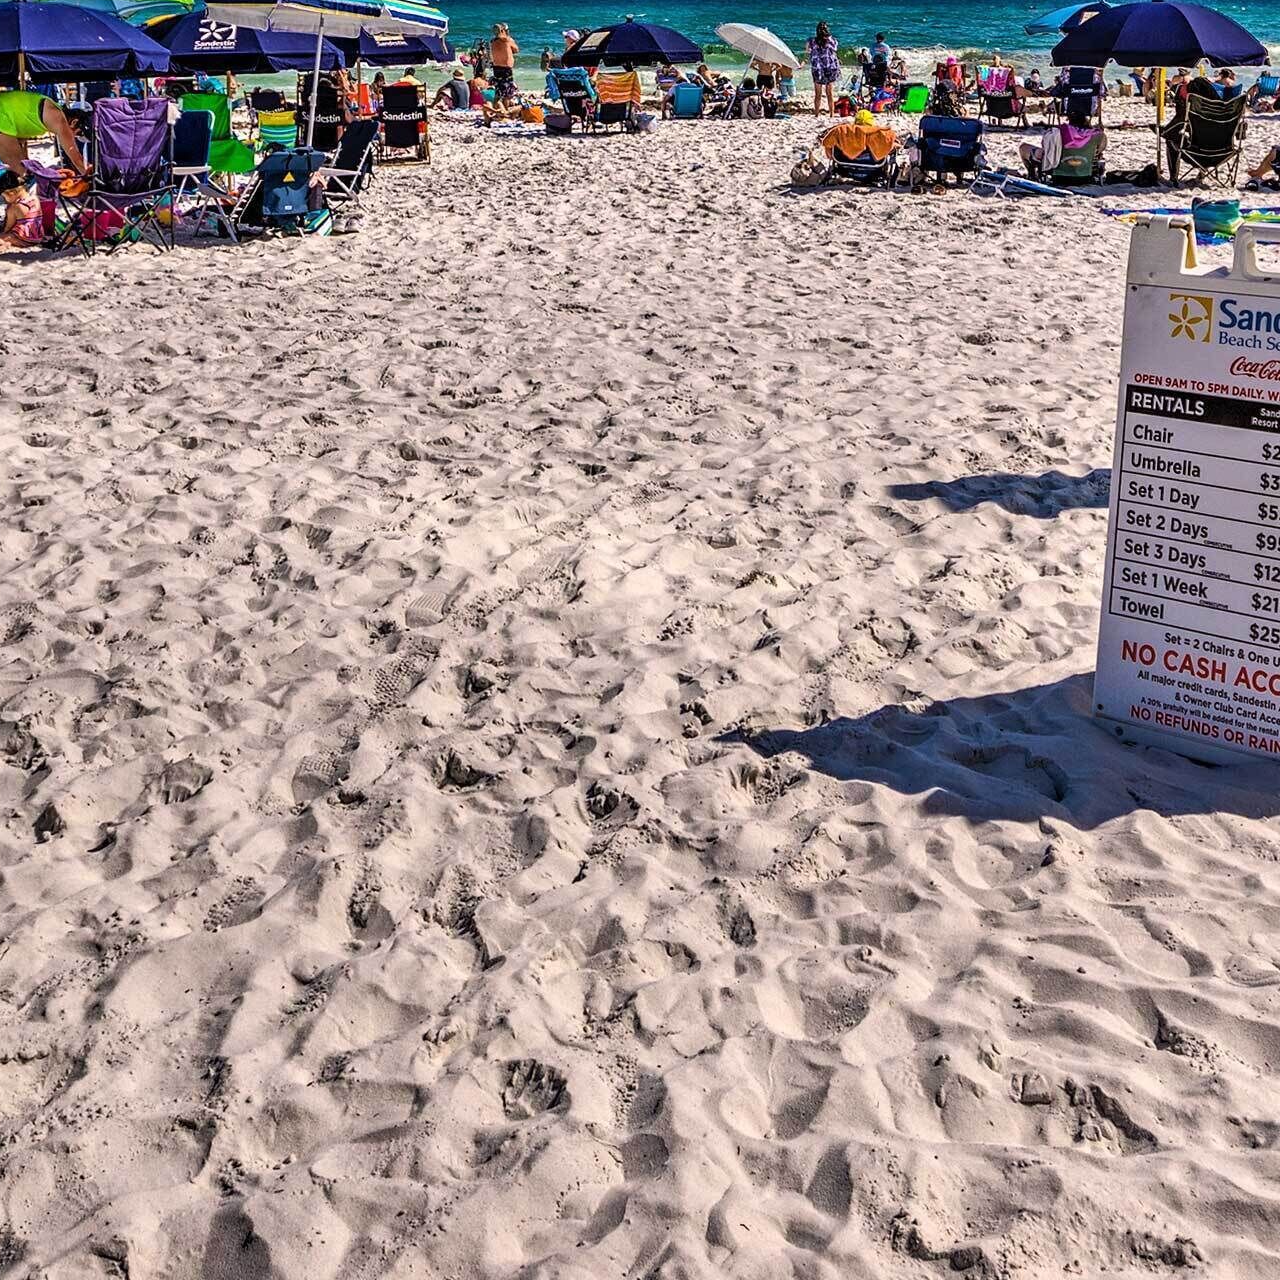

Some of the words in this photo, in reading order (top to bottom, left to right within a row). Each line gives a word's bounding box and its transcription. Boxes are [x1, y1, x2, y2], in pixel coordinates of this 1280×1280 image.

[382, 111, 423, 121] Sandestin
[1219, 331, 1262, 349] Beach
[1134, 373, 1162, 386] OPEN
[1165, 377, 1188, 390] 9AM
[1190, 380, 1205, 392] TO
[1207, 383, 1229, 395] 5PM
[1232, 386, 1265, 400] DAILY.
[1131, 392, 1205, 416] RENTALS
[1133, 424, 1174, 444] Chair
[1251, 416, 1279, 429] Resort
[1130, 452, 1201, 478] Umbrella
[1128, 481, 1154, 499] Set
[1158, 486, 1165, 501] 1
[1169, 488, 1200, 509] Day
[1126, 509, 1152, 528] Set
[1155, 515, 1166, 531] 2
[1170, 517, 1209, 539] Days
[1124, 538, 1150, 557] Set
[1154, 544, 1164, 560] 3
[1168, 546, 1207, 569] Days
[1121, 567, 1147, 586] Set
[1152, 573, 1158, 588] 1
[1163, 575, 1208, 599] Week
[1119, 595, 1164, 619] Towel
[1121, 639, 1156, 666] NO
[1163, 649, 1227, 683] CASH
[1164, 632, 1182, 646] Set
[1193, 639, 1200, 650] 2
[1202, 641, 1235, 658] Chairs
[1237, 648, 1245, 660] &
[1247, 651, 1270, 665] One
[1137, 670, 1149, 681] All
[1151, 674, 1176, 686] major
[1177, 680, 1203, 693] credit
[1204, 686, 1231, 701] cards,
[1232, 692, 1276, 711] Sandestin
[1141, 696, 1147, 704] A
[1147, 698, 1162, 708] 20%
[1162, 702, 1188, 716] gratuity
[1189, 709, 1201, 717] will
[1202, 711, 1211, 720] be
[1211, 714, 1234, 725] added
[1235, 718, 1245, 729] for
[1246, 721, 1258, 732] the
[1258, 726, 1280, 737] rental
[1174, 692, 1181, 701] &
[1182, 694, 1212, 709] Owner
[1213, 701, 1234, 714] Club
[1236, 707, 1257, 720] Card
[1130, 704, 1151, 721] NO
[1155, 711, 1220, 739] REFUNDS
[1223, 728, 1245, 745] OR
